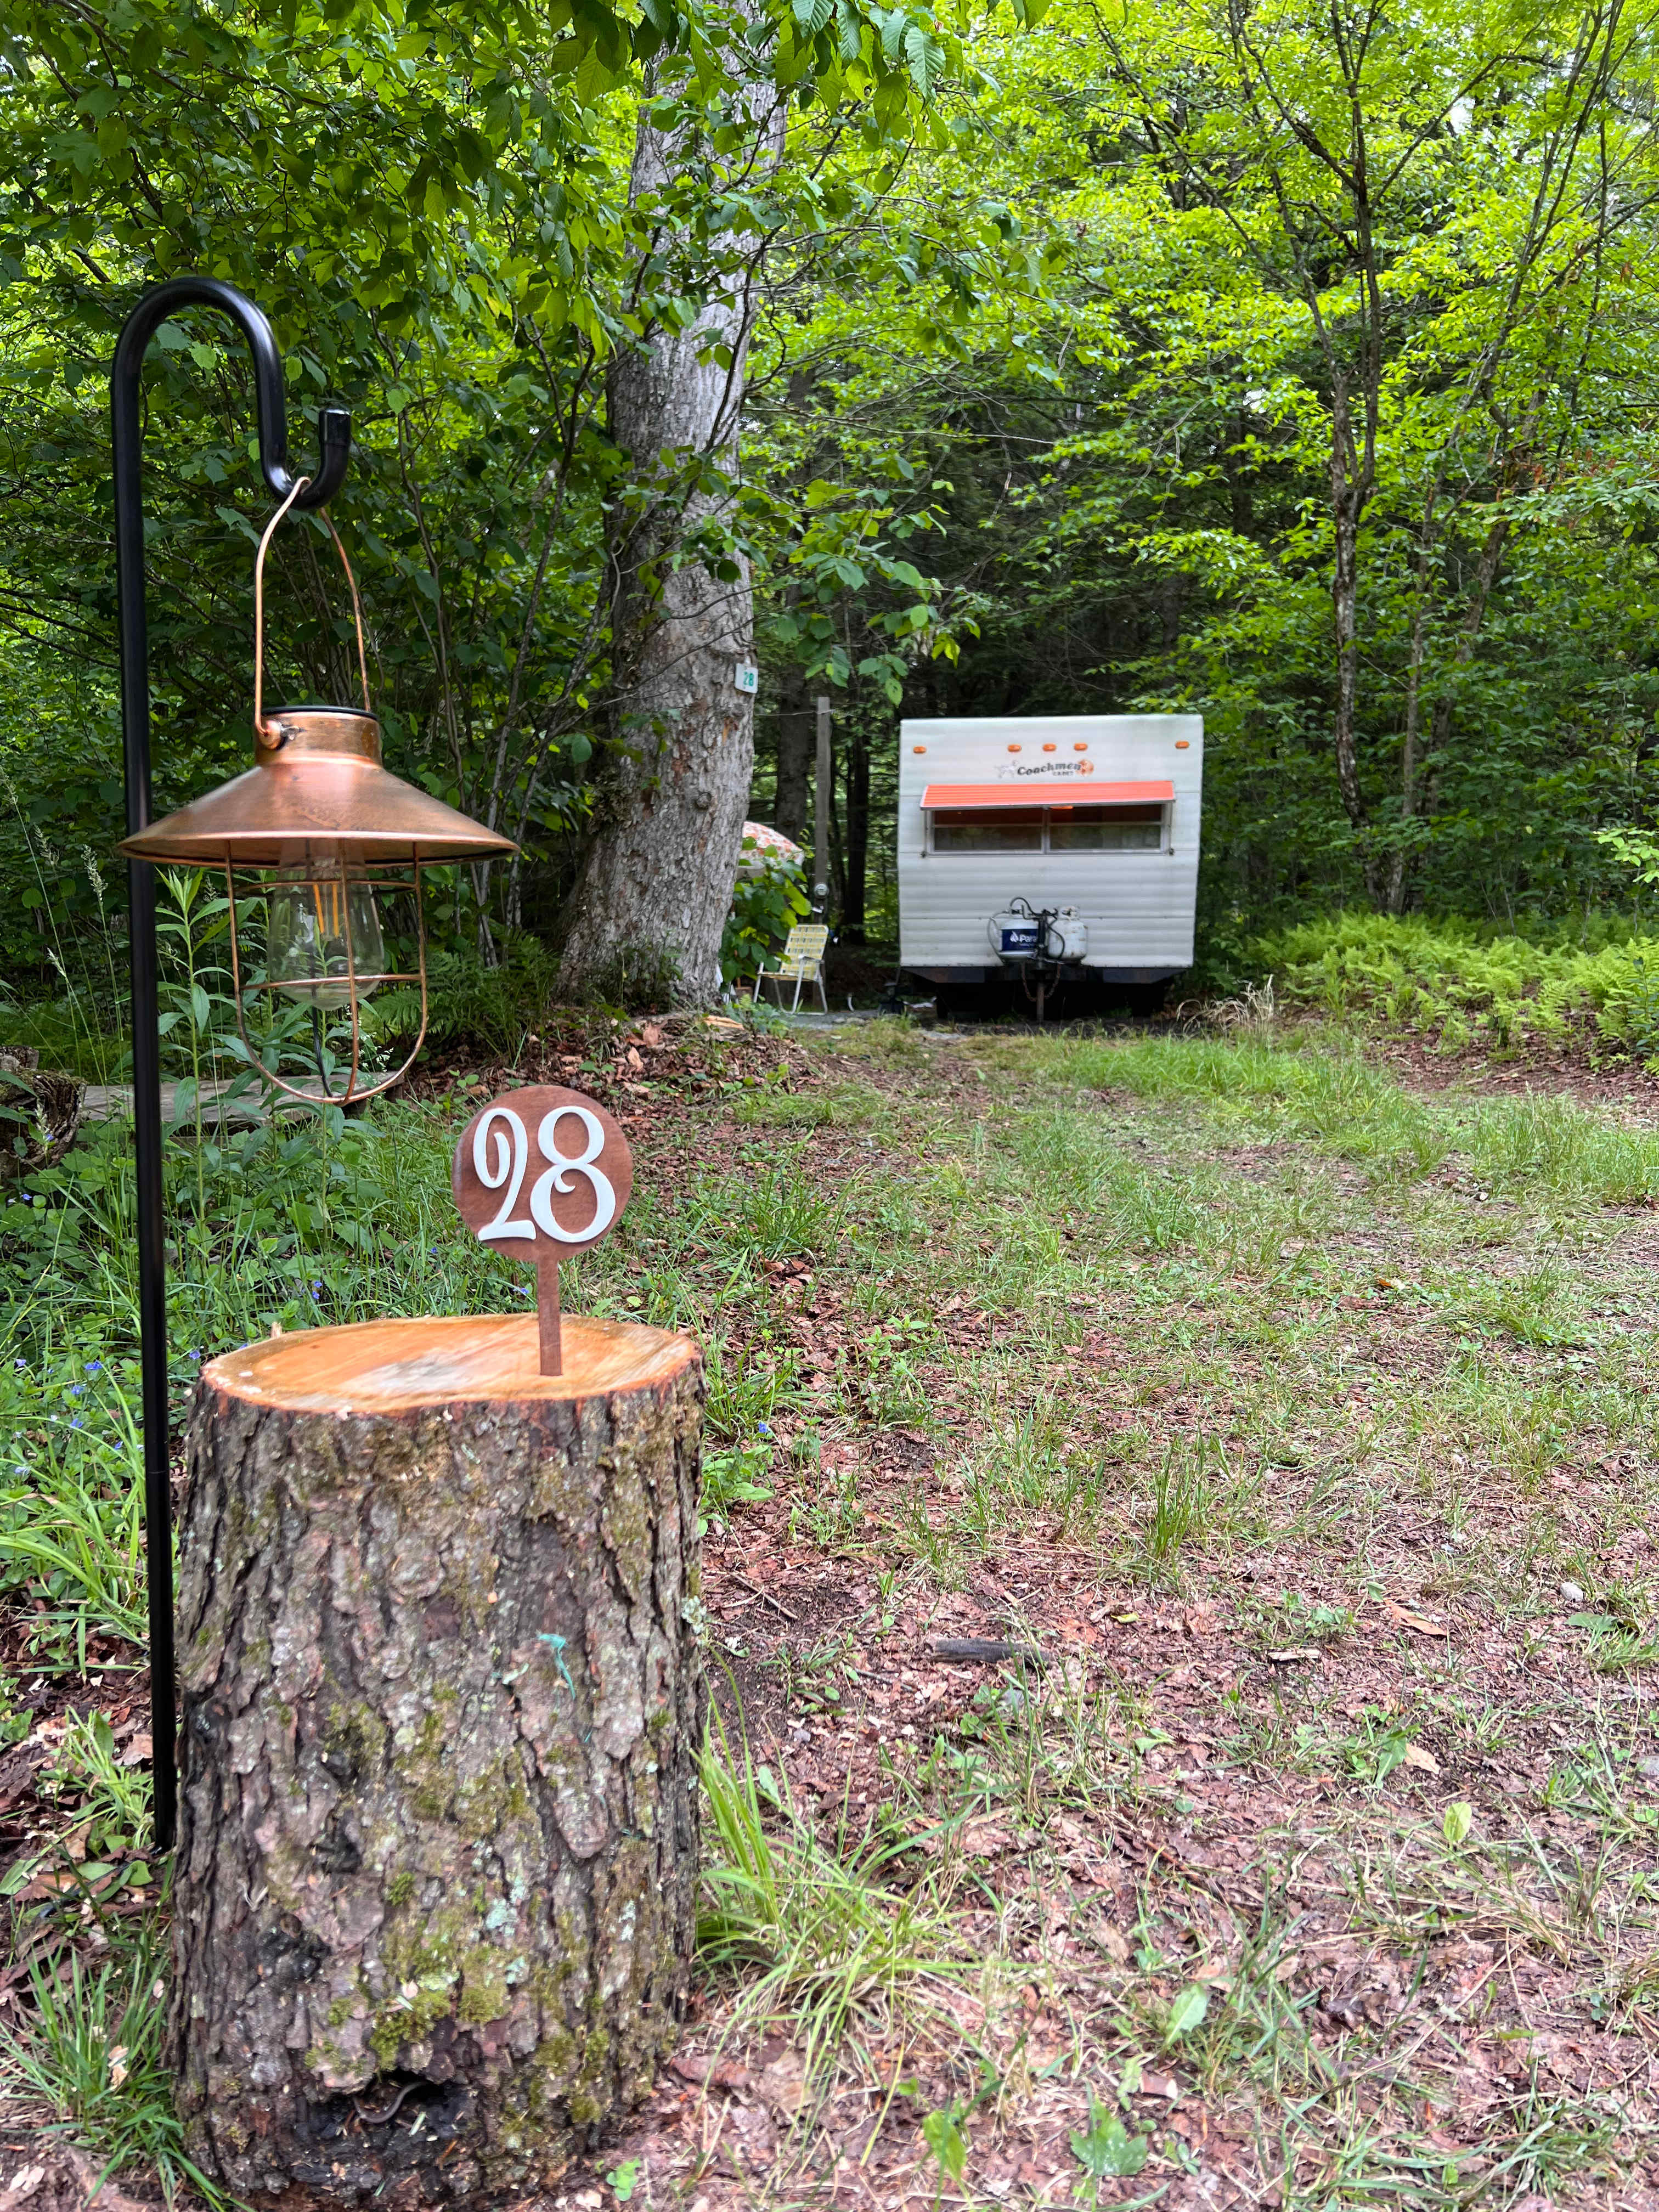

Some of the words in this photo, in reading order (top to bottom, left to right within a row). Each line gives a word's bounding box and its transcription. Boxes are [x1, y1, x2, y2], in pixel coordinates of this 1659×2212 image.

[743, 671, 754, 686] 28
[1017, 762, 1081, 776] Coachmen
[1019, 934, 1037, 943] Para
[473, 1105, 616, 1243] 28
